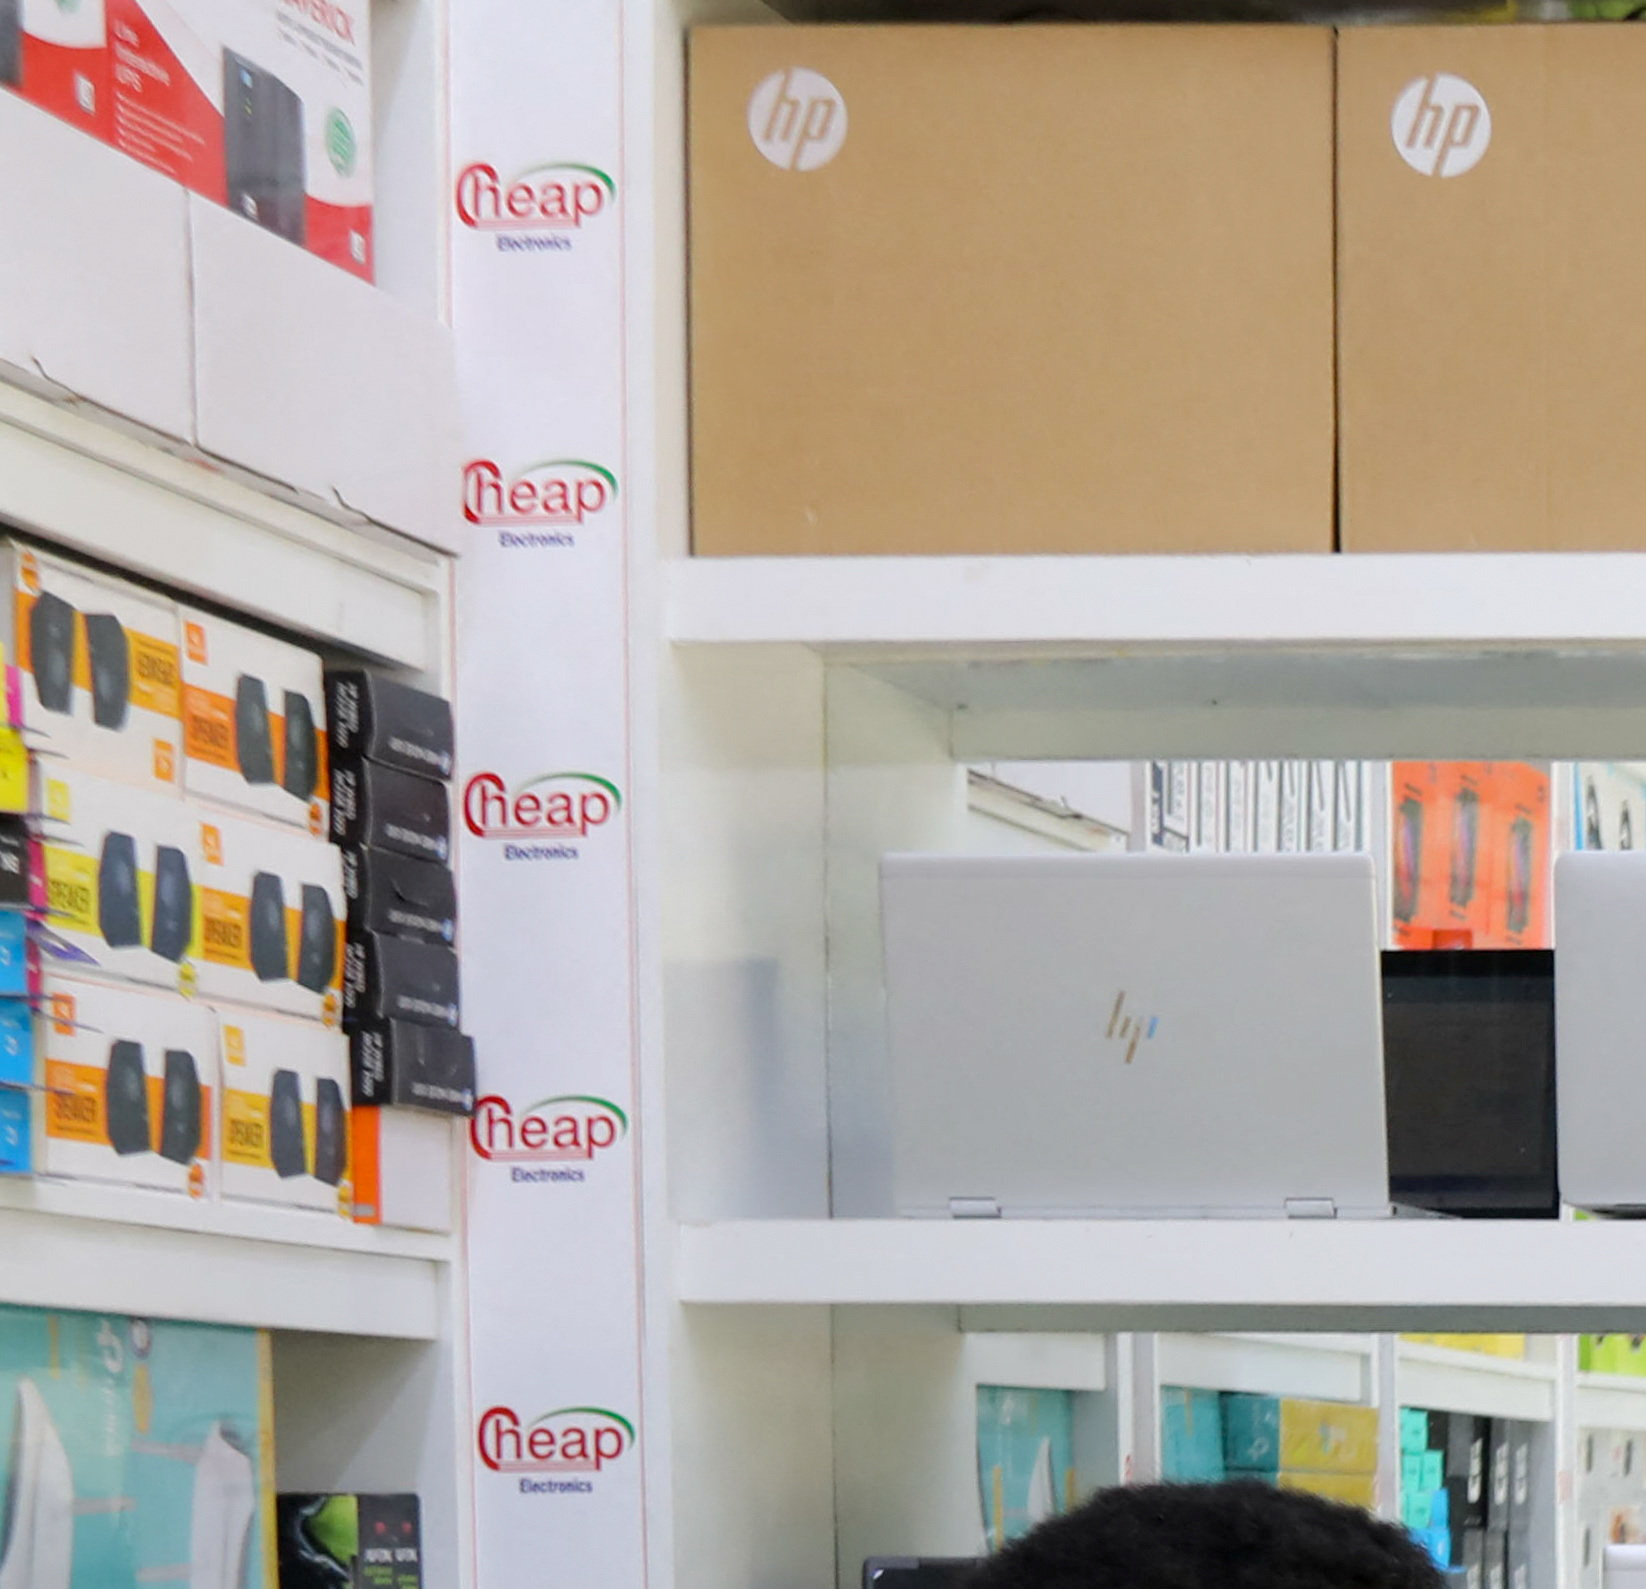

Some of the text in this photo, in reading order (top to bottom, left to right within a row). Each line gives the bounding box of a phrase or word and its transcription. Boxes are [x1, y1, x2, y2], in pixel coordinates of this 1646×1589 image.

[763, 67, 836, 171] hp
[1406, 73, 1480, 177] hp
[455, 162, 604, 228] Cheap
[463, 460, 607, 525] Cheap
[464, 772, 610, 838] Cheap
[470, 1095, 618, 1161] Cheap
[478, 1406, 625, 1472] Cheap
